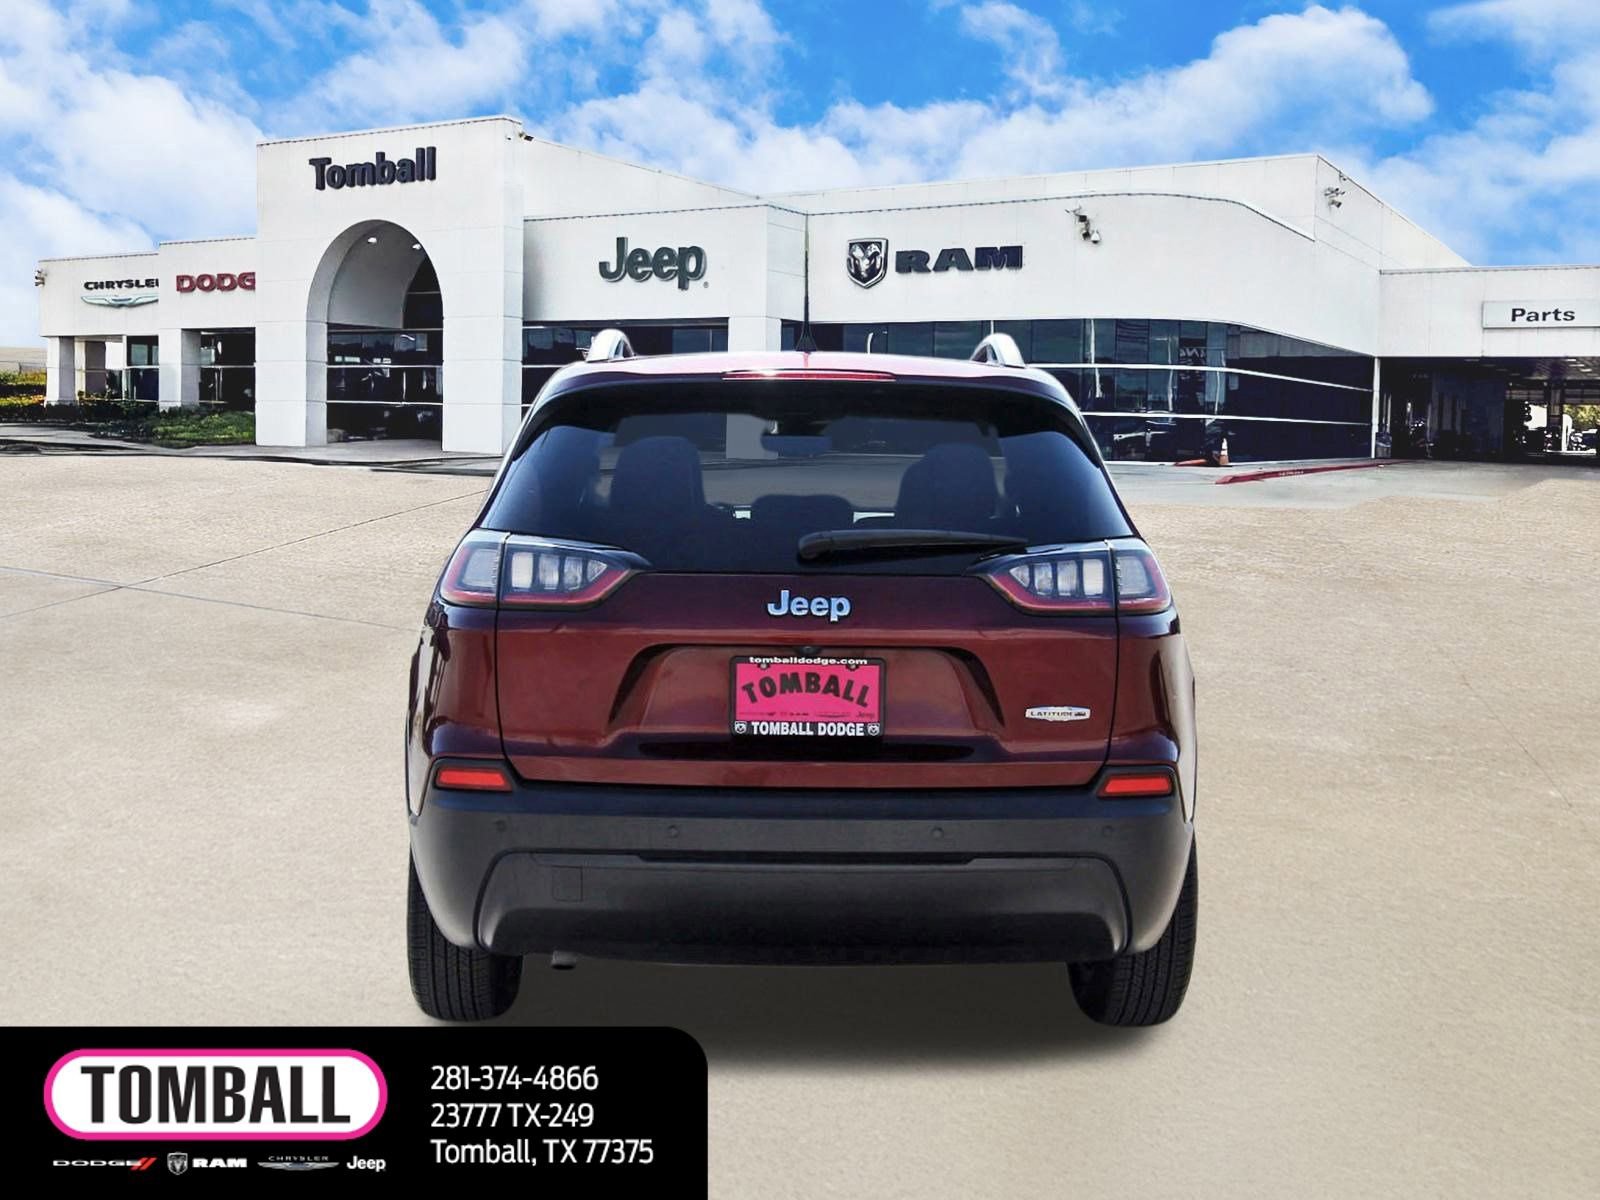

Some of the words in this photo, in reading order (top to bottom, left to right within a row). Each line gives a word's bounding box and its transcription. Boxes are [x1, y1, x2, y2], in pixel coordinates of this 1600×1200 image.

[309, 146, 437, 190] Tomball
[599, 237, 707, 290] Jeep
[895, 245, 1023, 273] RAM
[1511, 307, 1576, 322] Parts
[767, 589, 851, 622] Jeep
[749, 656, 868, 665] tomballdodge.com
[742, 672, 870, 708] TOMBALL
[751, 721, 814, 735] TOMBALL
[817, 722, 865, 736] DODGE
